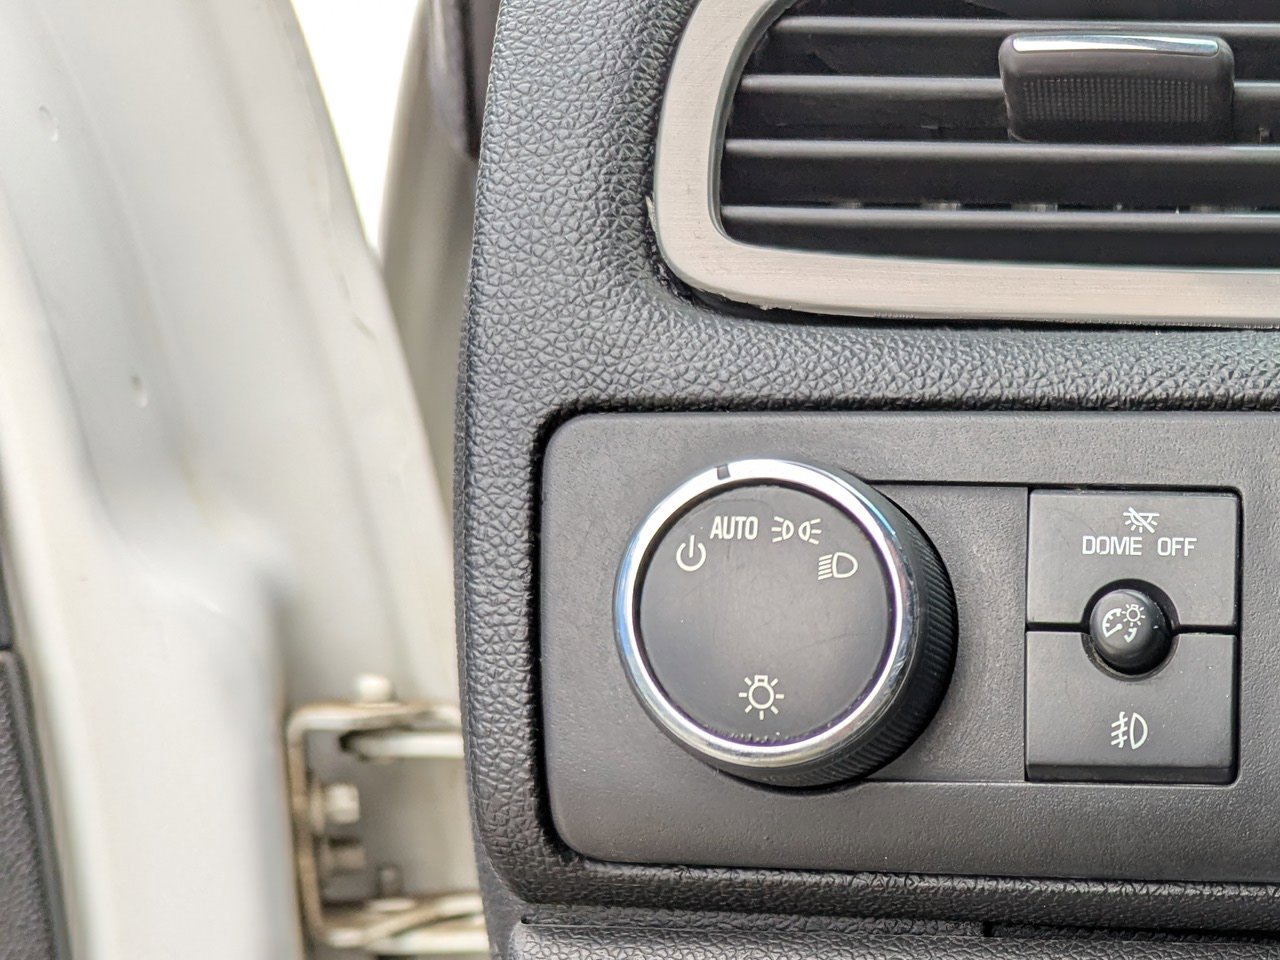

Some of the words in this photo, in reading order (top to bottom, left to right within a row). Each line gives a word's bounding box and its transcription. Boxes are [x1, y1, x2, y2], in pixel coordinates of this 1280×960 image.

[709, 515, 759, 540] AUTO
[1082, 535, 1143, 556] DOME
[1157, 537, 1197, 557] OFF
